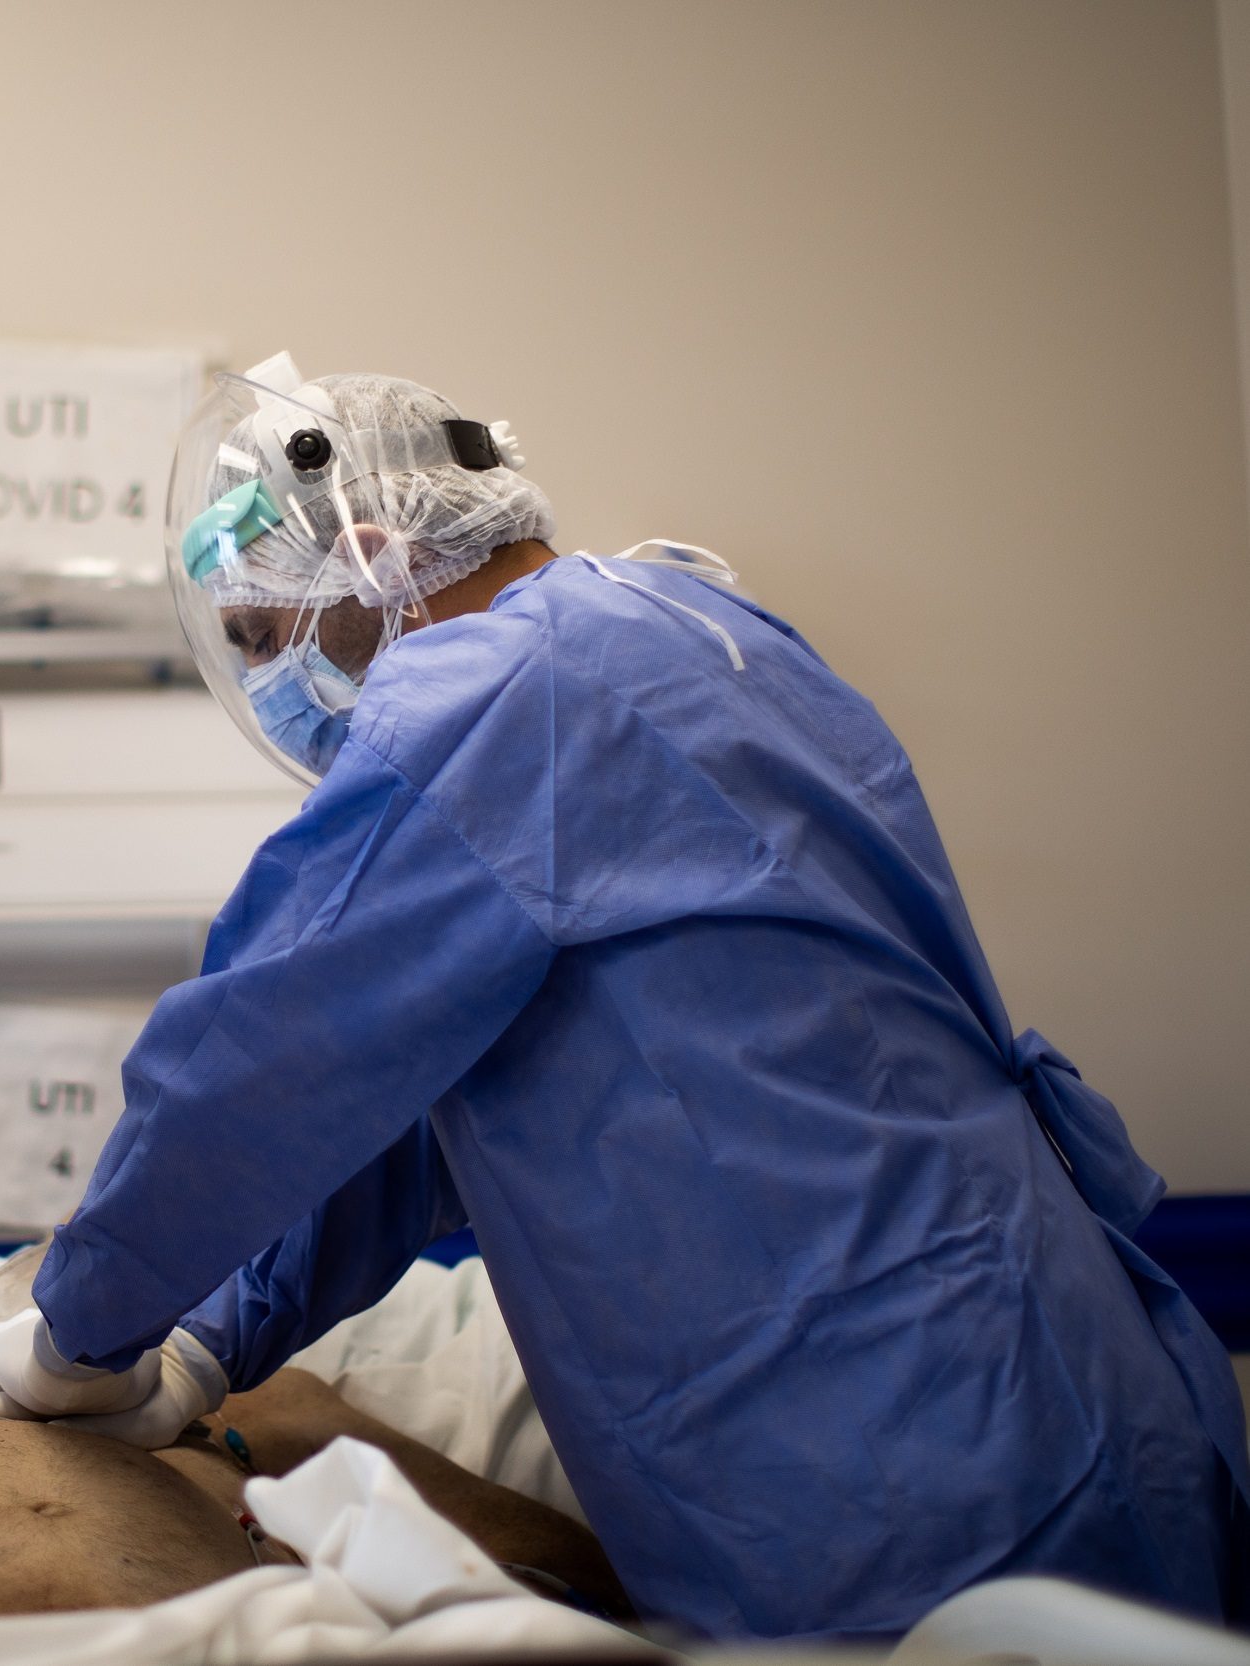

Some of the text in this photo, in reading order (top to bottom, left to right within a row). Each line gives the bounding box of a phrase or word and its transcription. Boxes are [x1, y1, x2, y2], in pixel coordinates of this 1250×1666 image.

[5, 395, 89, 440] UTI
[116, 482, 147, 523] 4
[28, 1076, 96, 1116] UTI
[50, 1147, 73, 1178] 4
